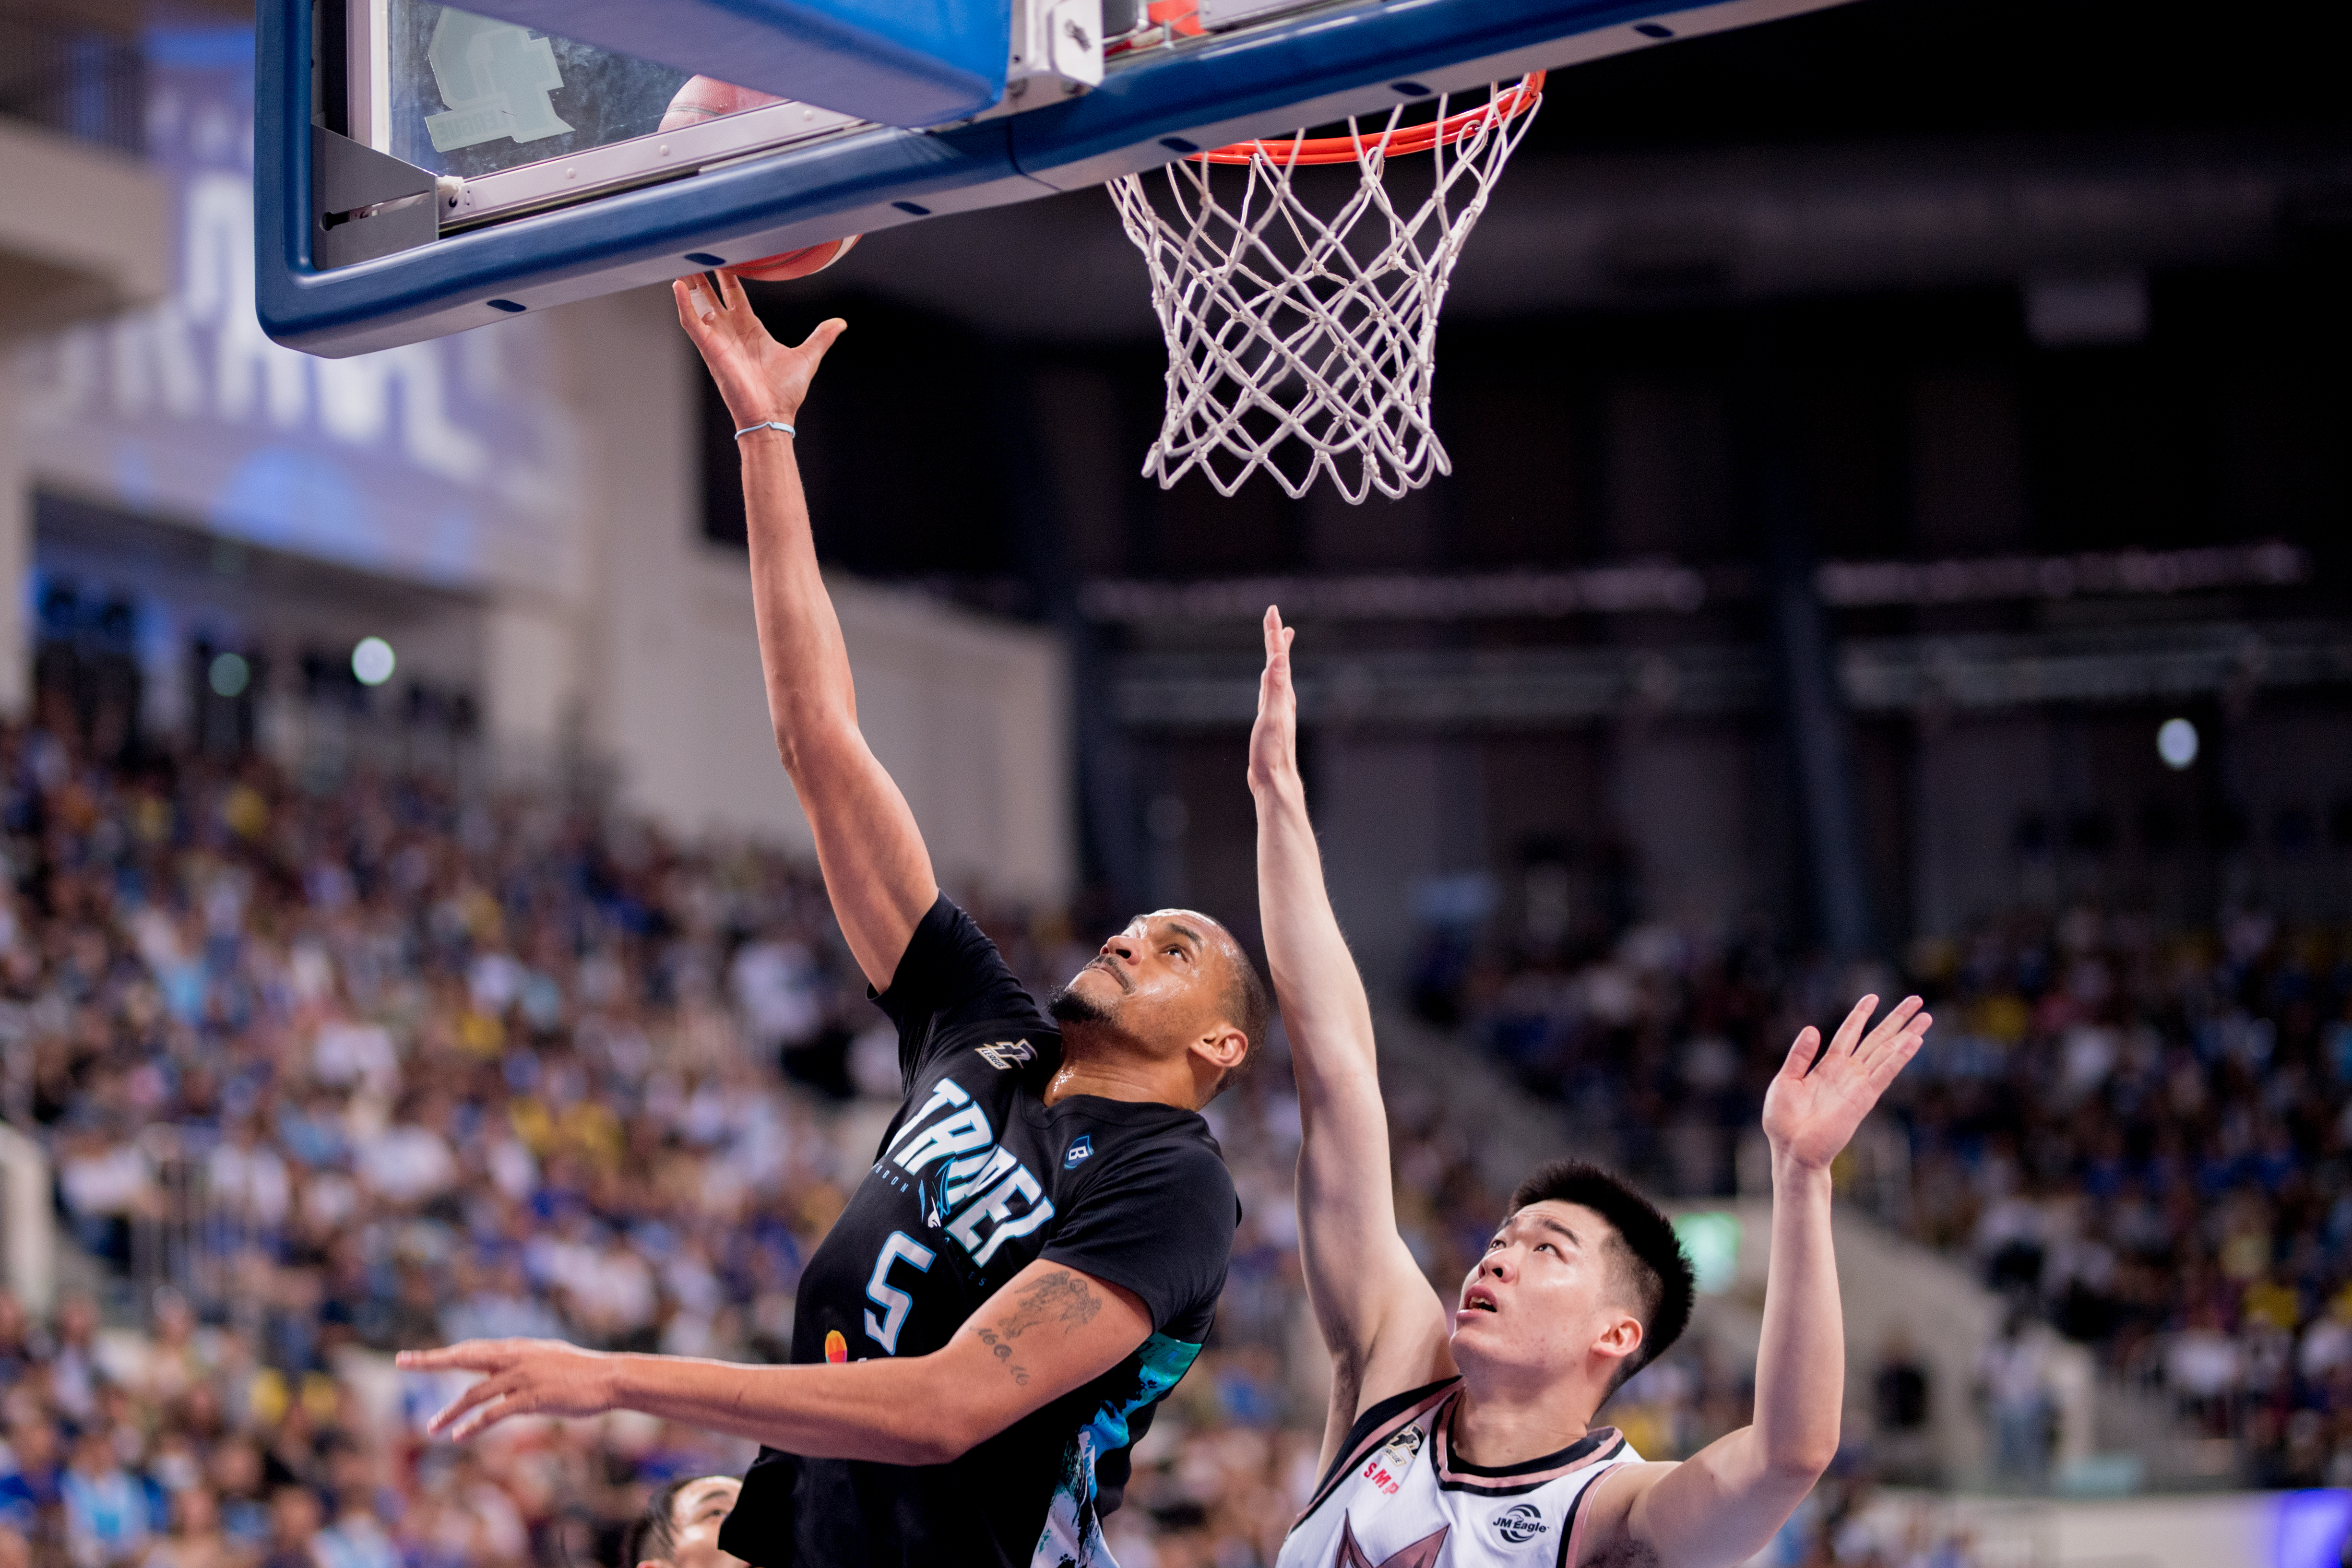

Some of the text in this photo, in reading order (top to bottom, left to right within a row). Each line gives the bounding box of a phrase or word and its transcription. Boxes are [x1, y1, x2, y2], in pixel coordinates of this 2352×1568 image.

[982, 1049, 1007, 1068] LEAGUE
[1068, 1145, 1089, 1161] B
[864, 1230, 937, 1355] 5
[1363, 1461, 1400, 1495] SMP
[1493, 1517, 1546, 1533] JM Eagle
